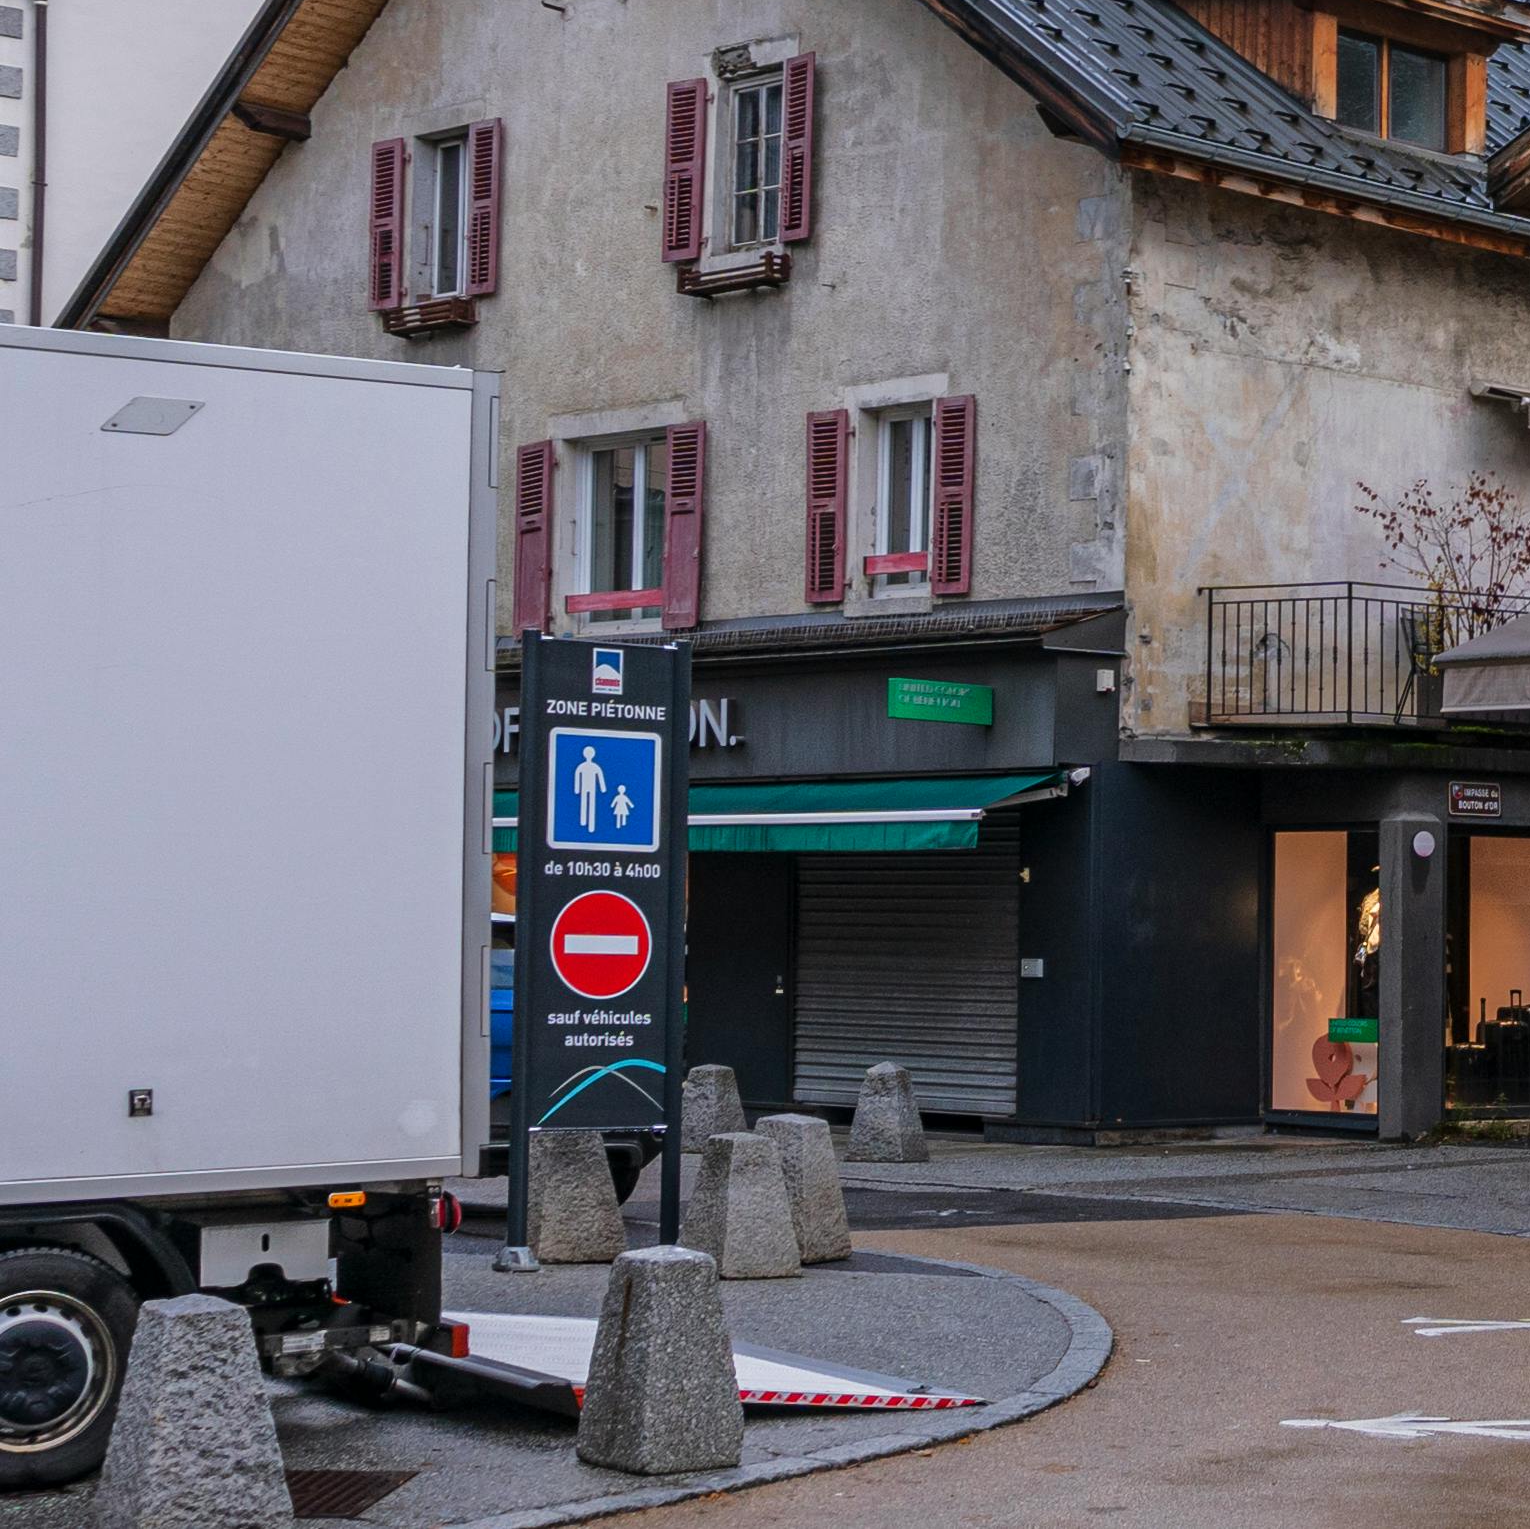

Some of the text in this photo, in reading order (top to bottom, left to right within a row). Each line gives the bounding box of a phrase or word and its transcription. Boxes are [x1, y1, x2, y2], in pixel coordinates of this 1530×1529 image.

[547, 699, 667, 720] ZONE PIÉTONNE
[1463, 788, 1489, 798] IMPASSE
[1458, 800, 1483, 810] BOUTON
[544, 860, 661, 878] de 10h30 à 4h00
[547, 1009, 652, 1025] sauf véhicules
[564, 1031, 634, 1046] autorisés
